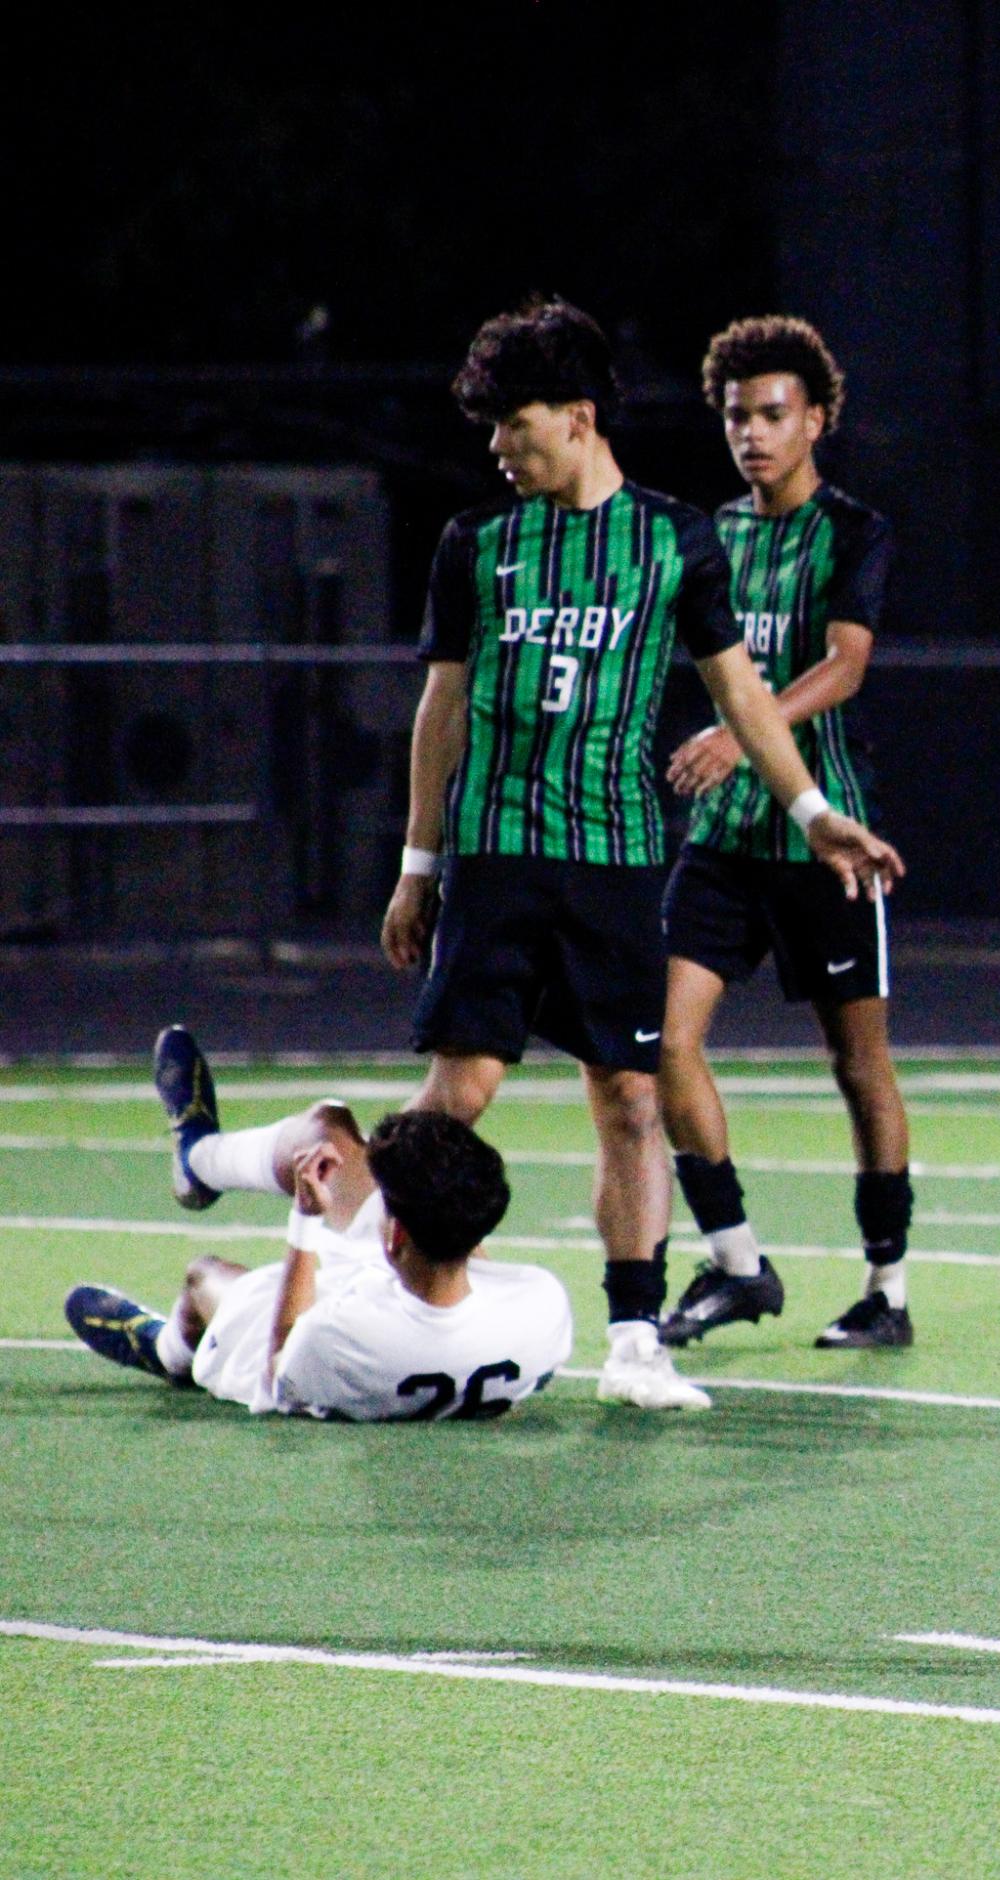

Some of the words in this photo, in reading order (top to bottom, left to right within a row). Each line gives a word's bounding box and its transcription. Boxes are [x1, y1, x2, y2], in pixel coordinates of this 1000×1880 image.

[499, 606, 634, 650] DERBY
[735, 612, 791, 656] RBY
[541, 655, 579, 712] 3
[397, 1359, 520, 1423] 26
